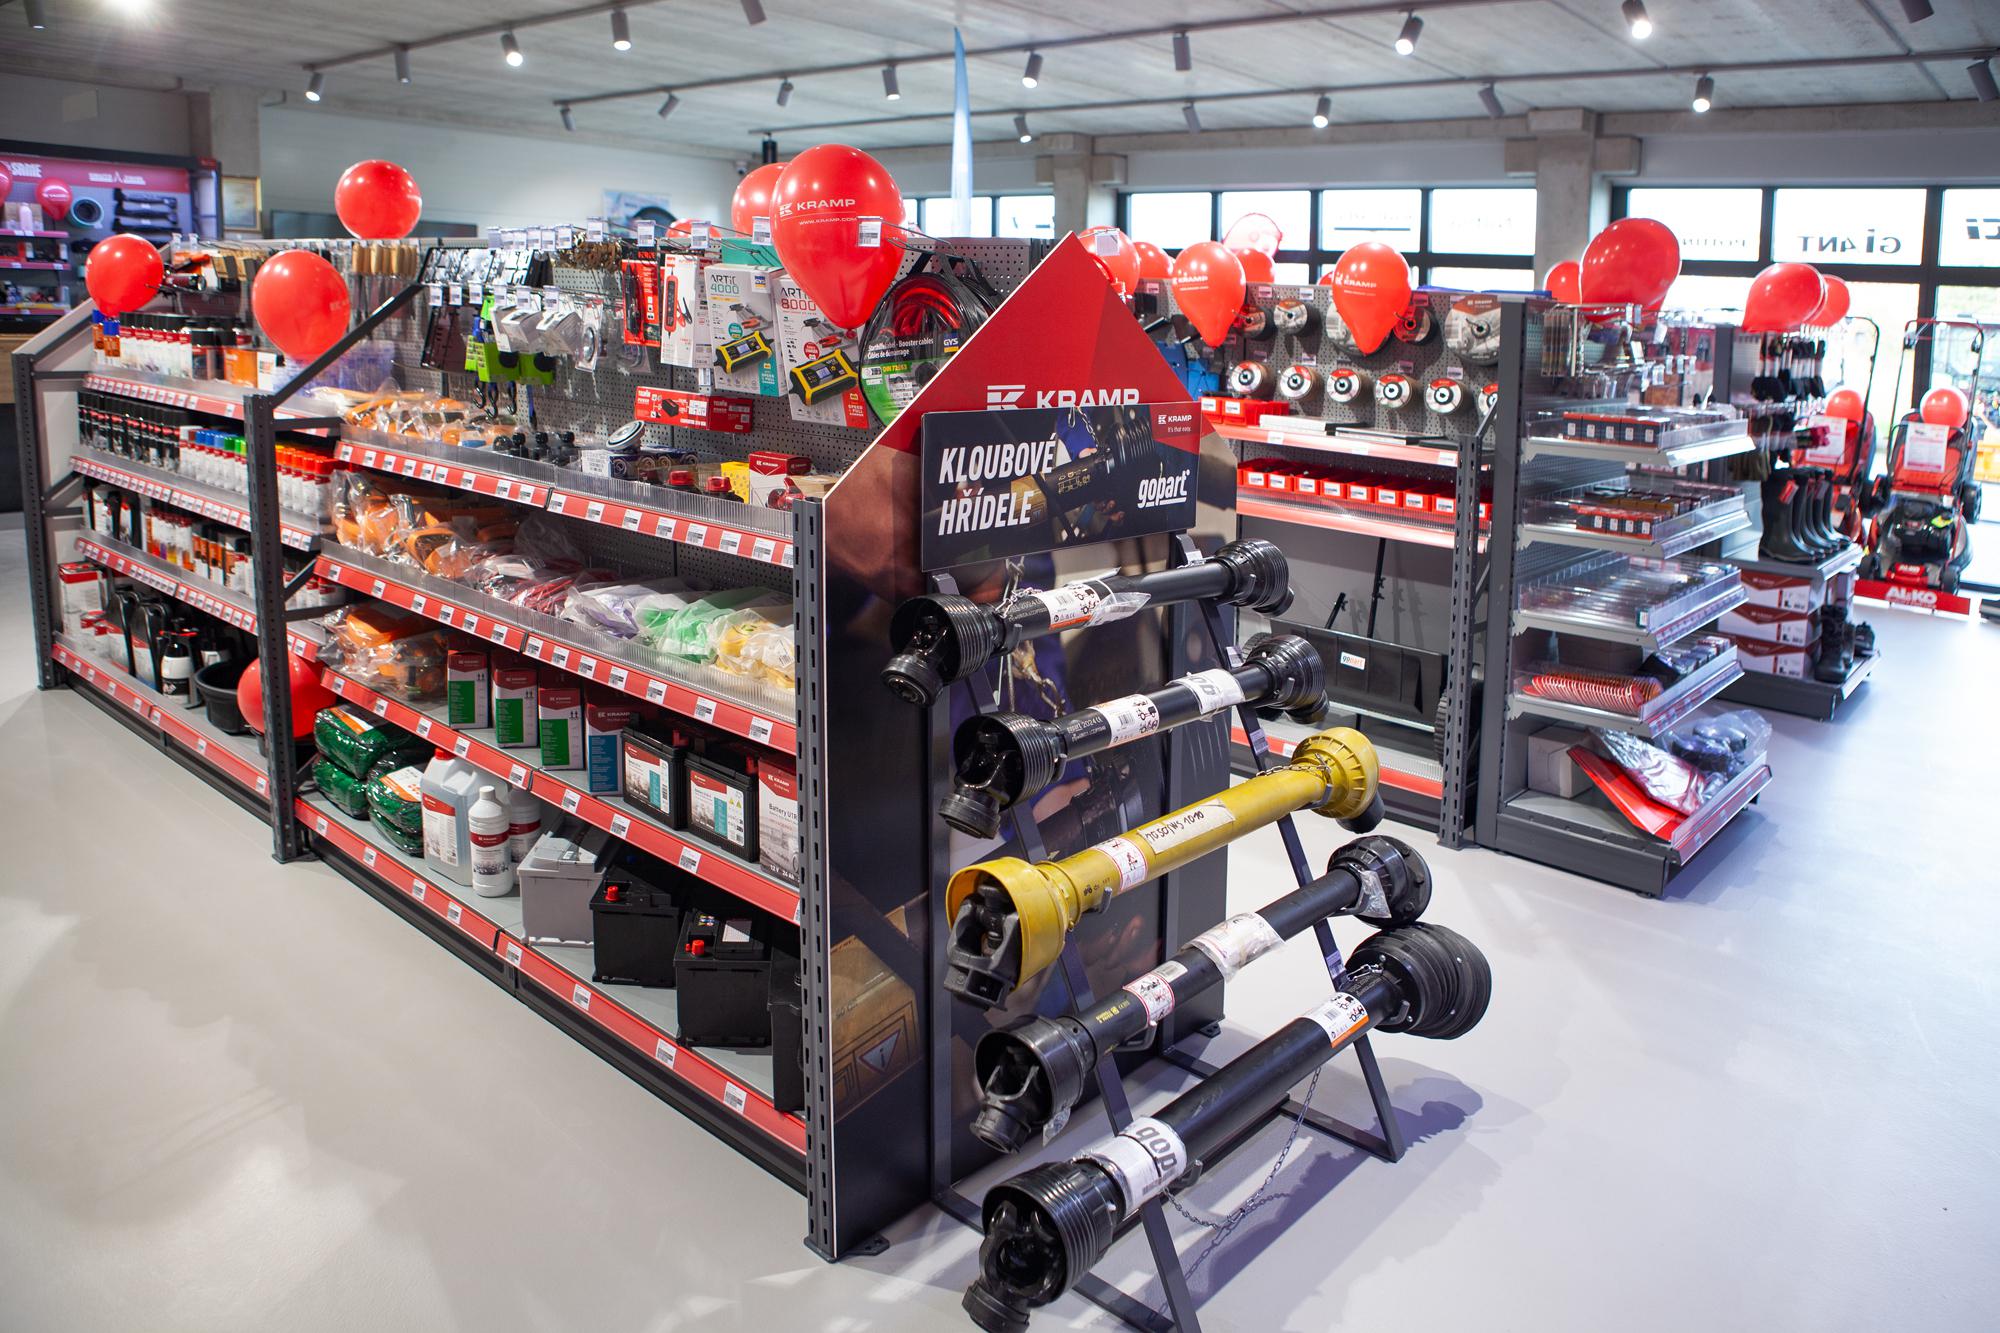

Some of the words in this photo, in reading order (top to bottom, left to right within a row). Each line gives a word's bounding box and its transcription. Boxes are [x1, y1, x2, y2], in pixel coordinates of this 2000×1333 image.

[796, 199, 856, 211] KRAMP
[710, 283, 740, 295] 4000
[781, 298, 817, 312] 8000
[943, 338, 959, 347] GYS
[1036, 388, 1140, 409] KRAMP
[1168, 414, 1192, 423] KRAMP
[938, 432, 1056, 485] KLOUBOVÉ
[1137, 470, 1188, 508] gopart
[938, 487, 1035, 536] HŘÍDELE
